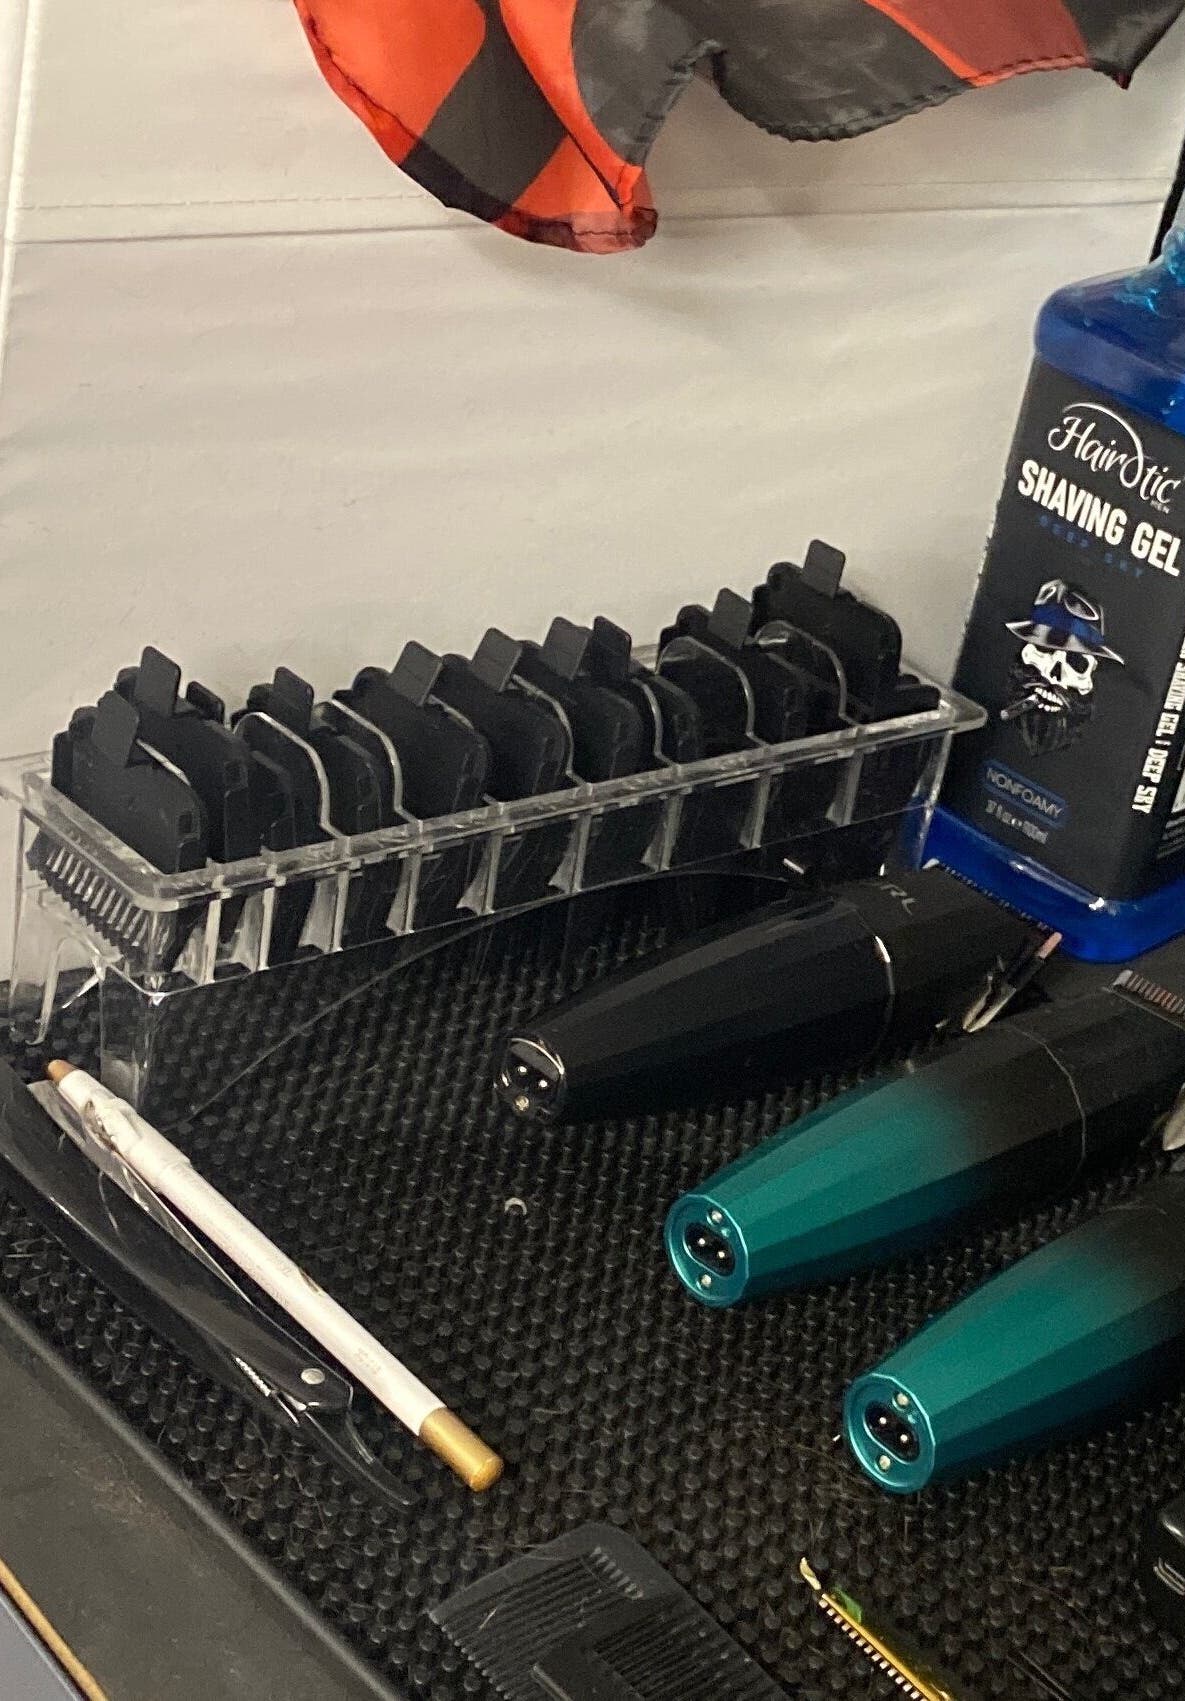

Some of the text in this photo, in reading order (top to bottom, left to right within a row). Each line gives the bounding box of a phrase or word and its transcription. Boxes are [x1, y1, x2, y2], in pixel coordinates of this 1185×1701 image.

[1017, 459, 1128, 546] SHAVING
[1130, 521, 1181, 577] GEL
[1155, 712, 1180, 737] GEL
[1142, 747, 1168, 783] DEEP
[1132, 784, 1158, 813] SKY
